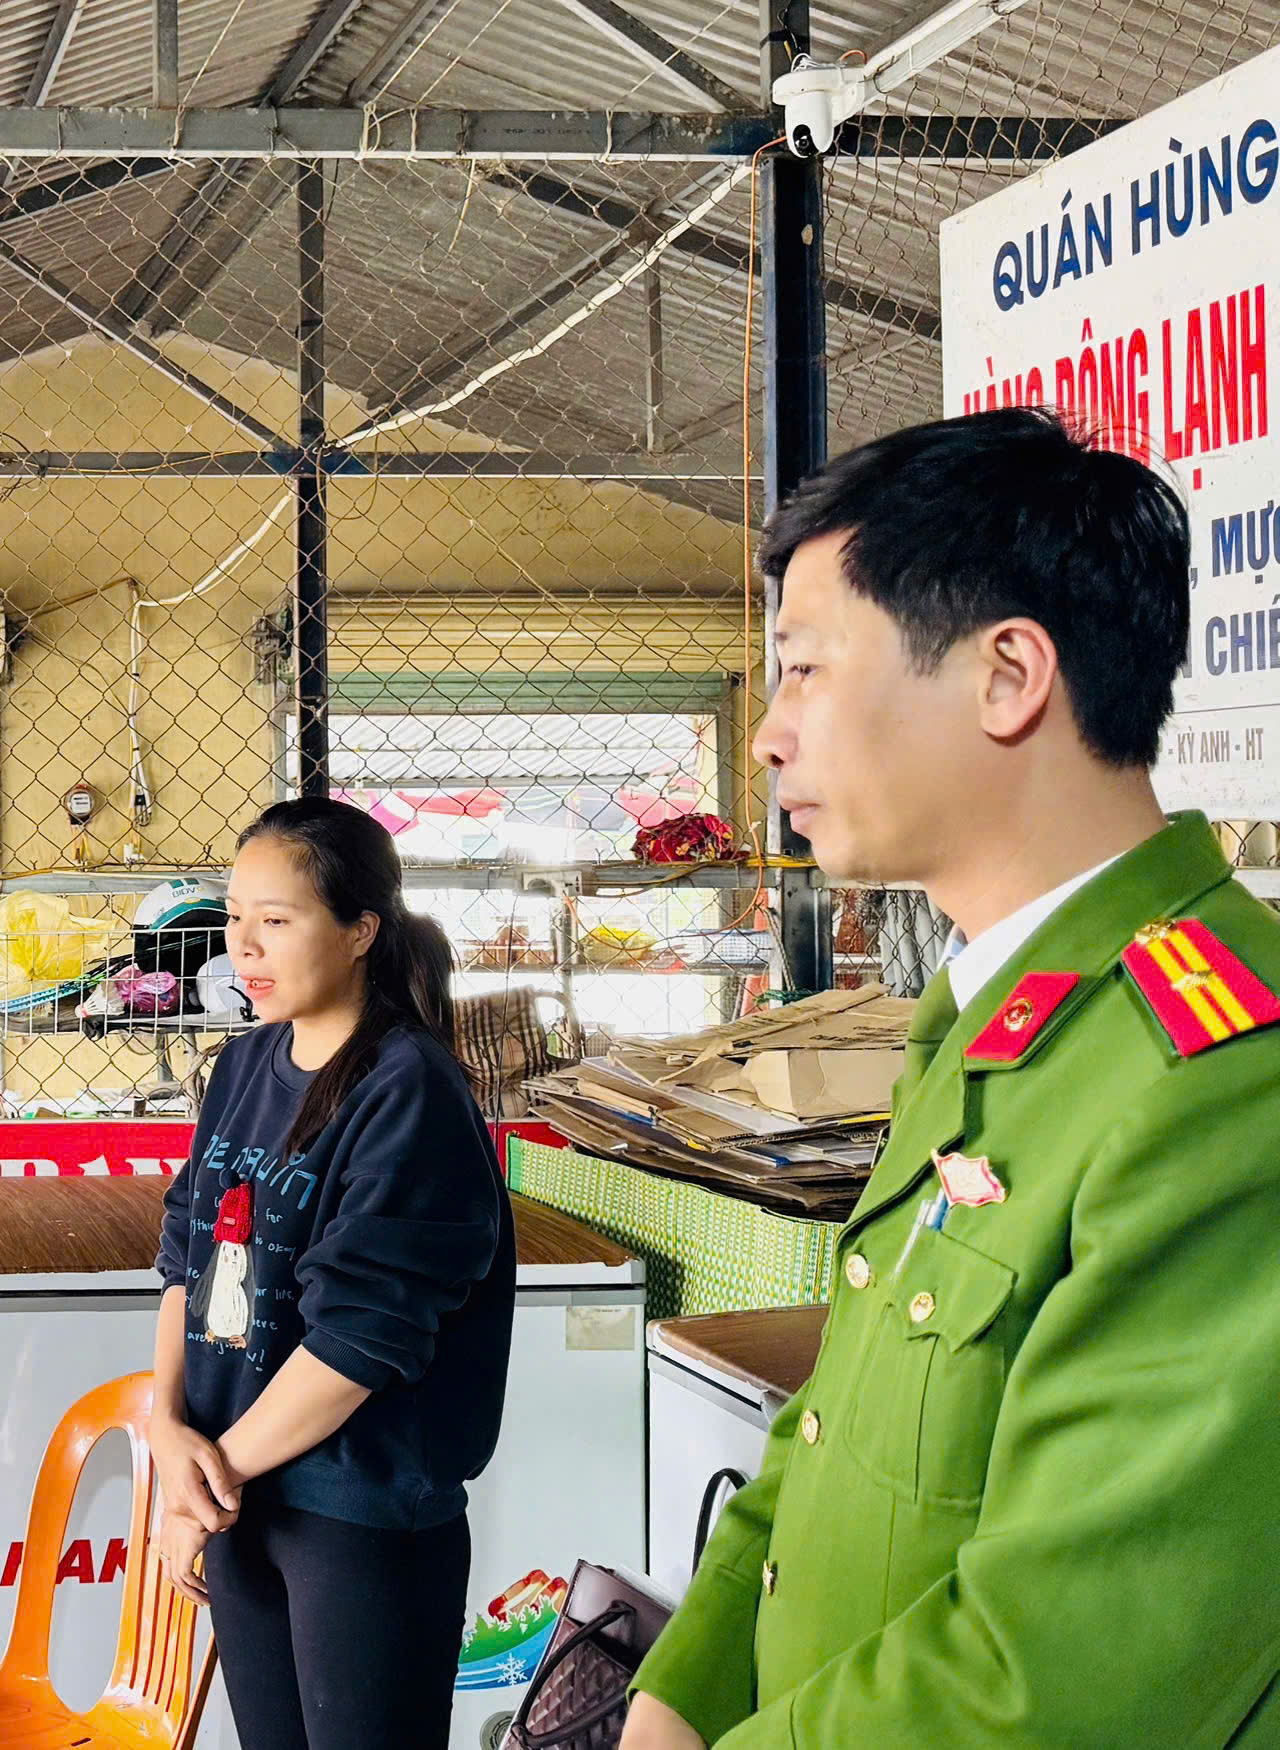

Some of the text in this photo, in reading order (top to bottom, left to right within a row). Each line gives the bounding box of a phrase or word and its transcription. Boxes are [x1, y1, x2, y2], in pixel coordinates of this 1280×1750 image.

[993, 118, 1280, 312] QUÁN HÙNG
[1162, 284, 1268, 490] LẠNH
[1211, 500, 1280, 584] MỰ
[1177, 725, 1195, 764] KỲ
[1200, 730, 1231, 763] ANH
[1245, 728, 1264, 760] HT
